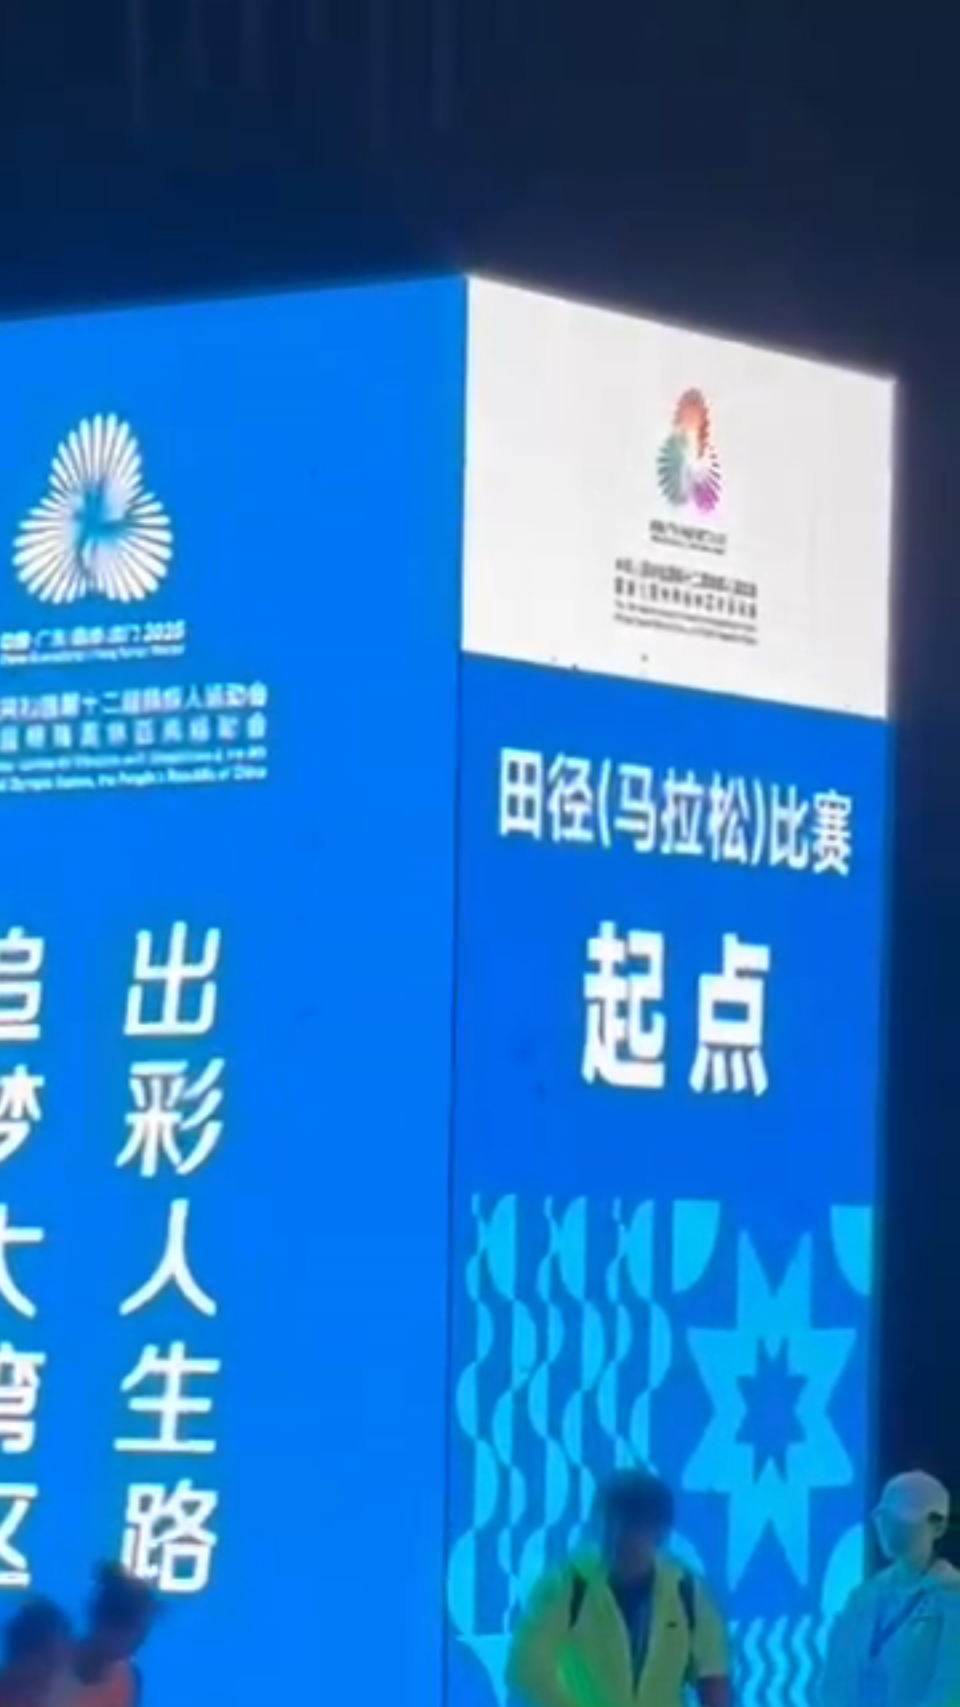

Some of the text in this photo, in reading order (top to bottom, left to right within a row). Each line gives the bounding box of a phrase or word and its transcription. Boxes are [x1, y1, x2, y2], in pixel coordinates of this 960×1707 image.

[499, 746, 852, 876] 田径(马拉松)比赛
[581, 920, 771, 1097] 起点
[114, 920, 224, 1593] 出彩人生路
